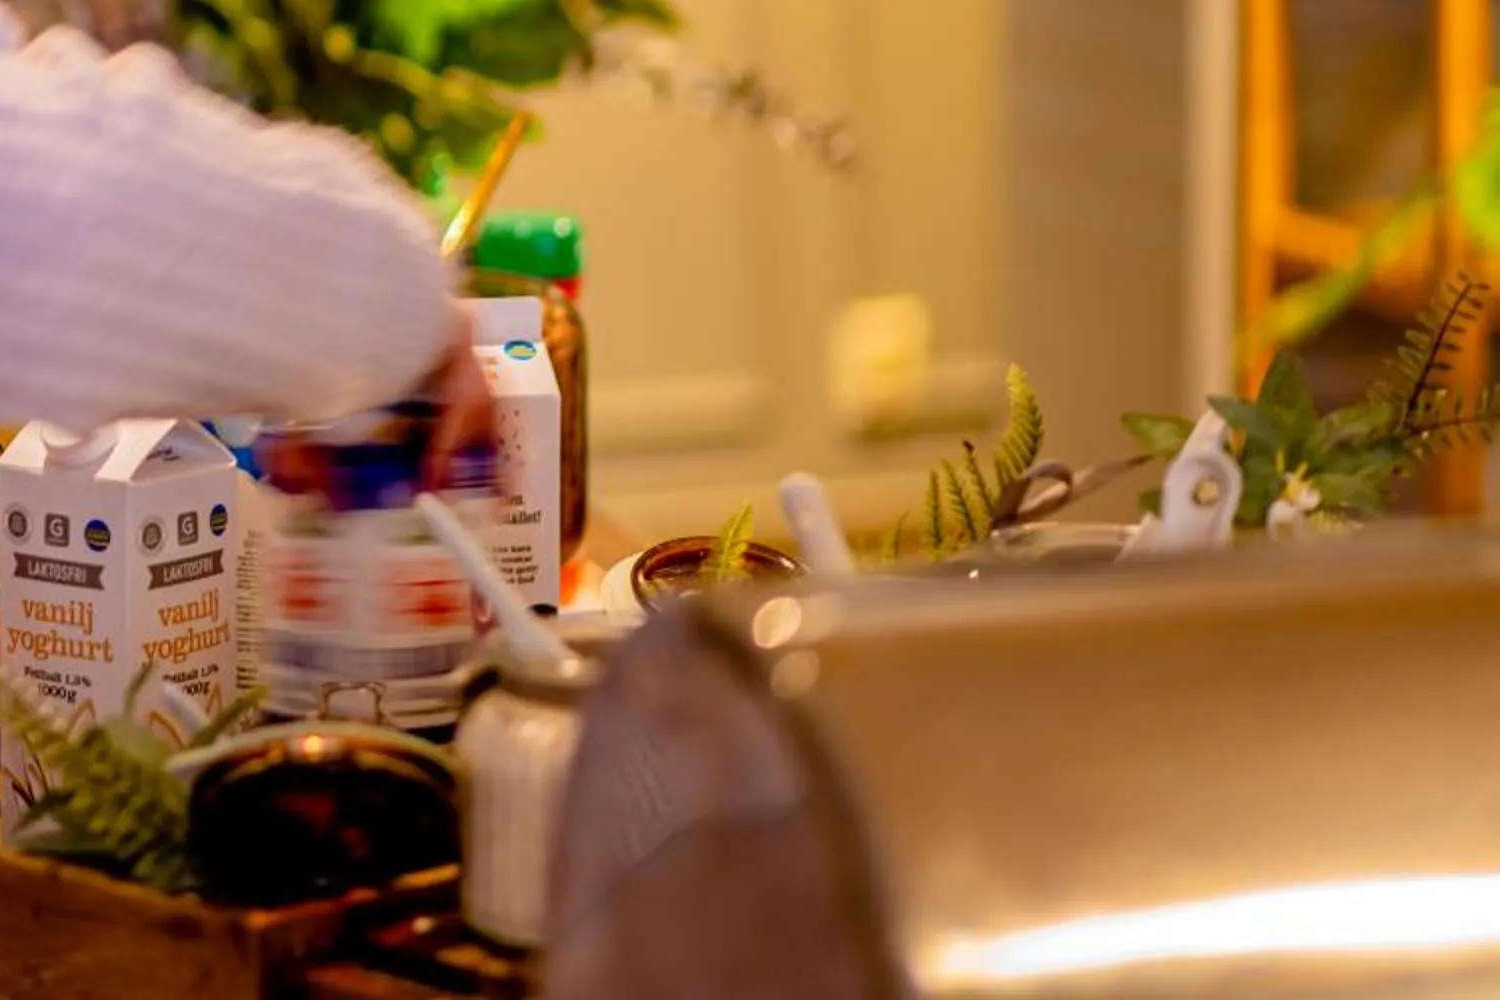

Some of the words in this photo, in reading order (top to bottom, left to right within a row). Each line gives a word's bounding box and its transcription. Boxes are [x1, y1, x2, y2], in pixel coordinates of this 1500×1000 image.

[27, 559, 87, 584] LAKTOSFRI
[163, 556, 213, 584] LAKTOSFRI
[22, 598, 94, 635] vanilj
[158, 587, 220, 628] vanilj
[7, 626, 114, 663] yoghurt
[143, 618, 230, 667] yoghurt
